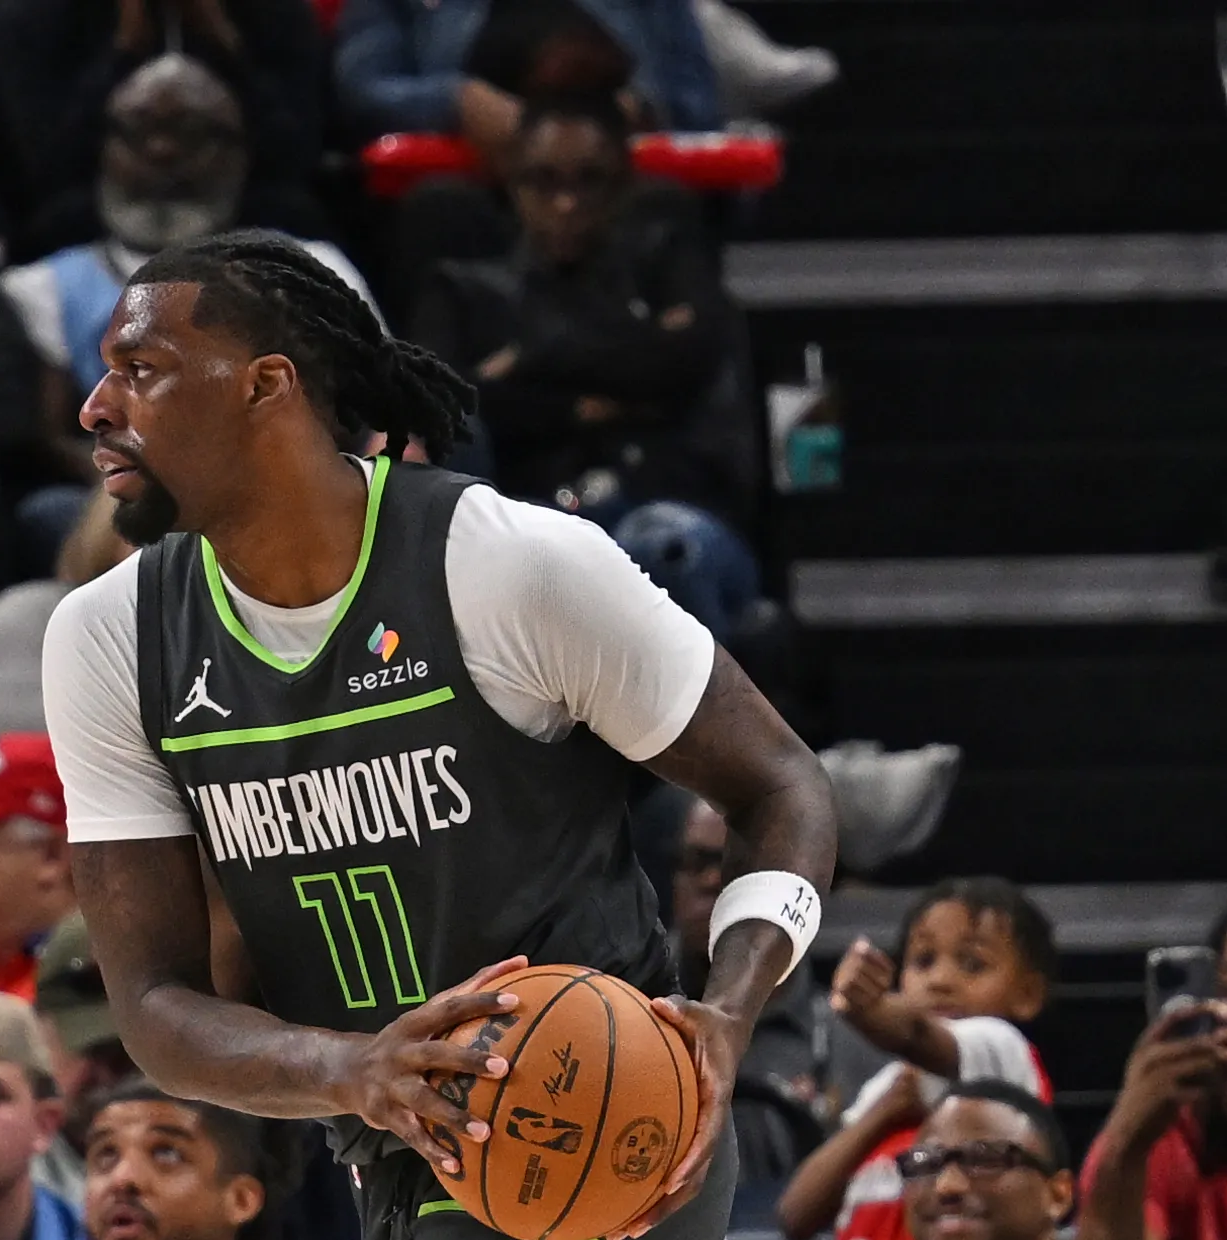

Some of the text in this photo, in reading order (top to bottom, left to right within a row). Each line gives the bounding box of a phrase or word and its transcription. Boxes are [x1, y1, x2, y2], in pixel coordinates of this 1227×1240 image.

[347, 657, 428, 693] sezzle
[186, 745, 471, 871] IMBERWOLVES
[795, 886, 813, 914] 11
[292, 865, 426, 1008] 11
[780, 903, 806, 934] NR
